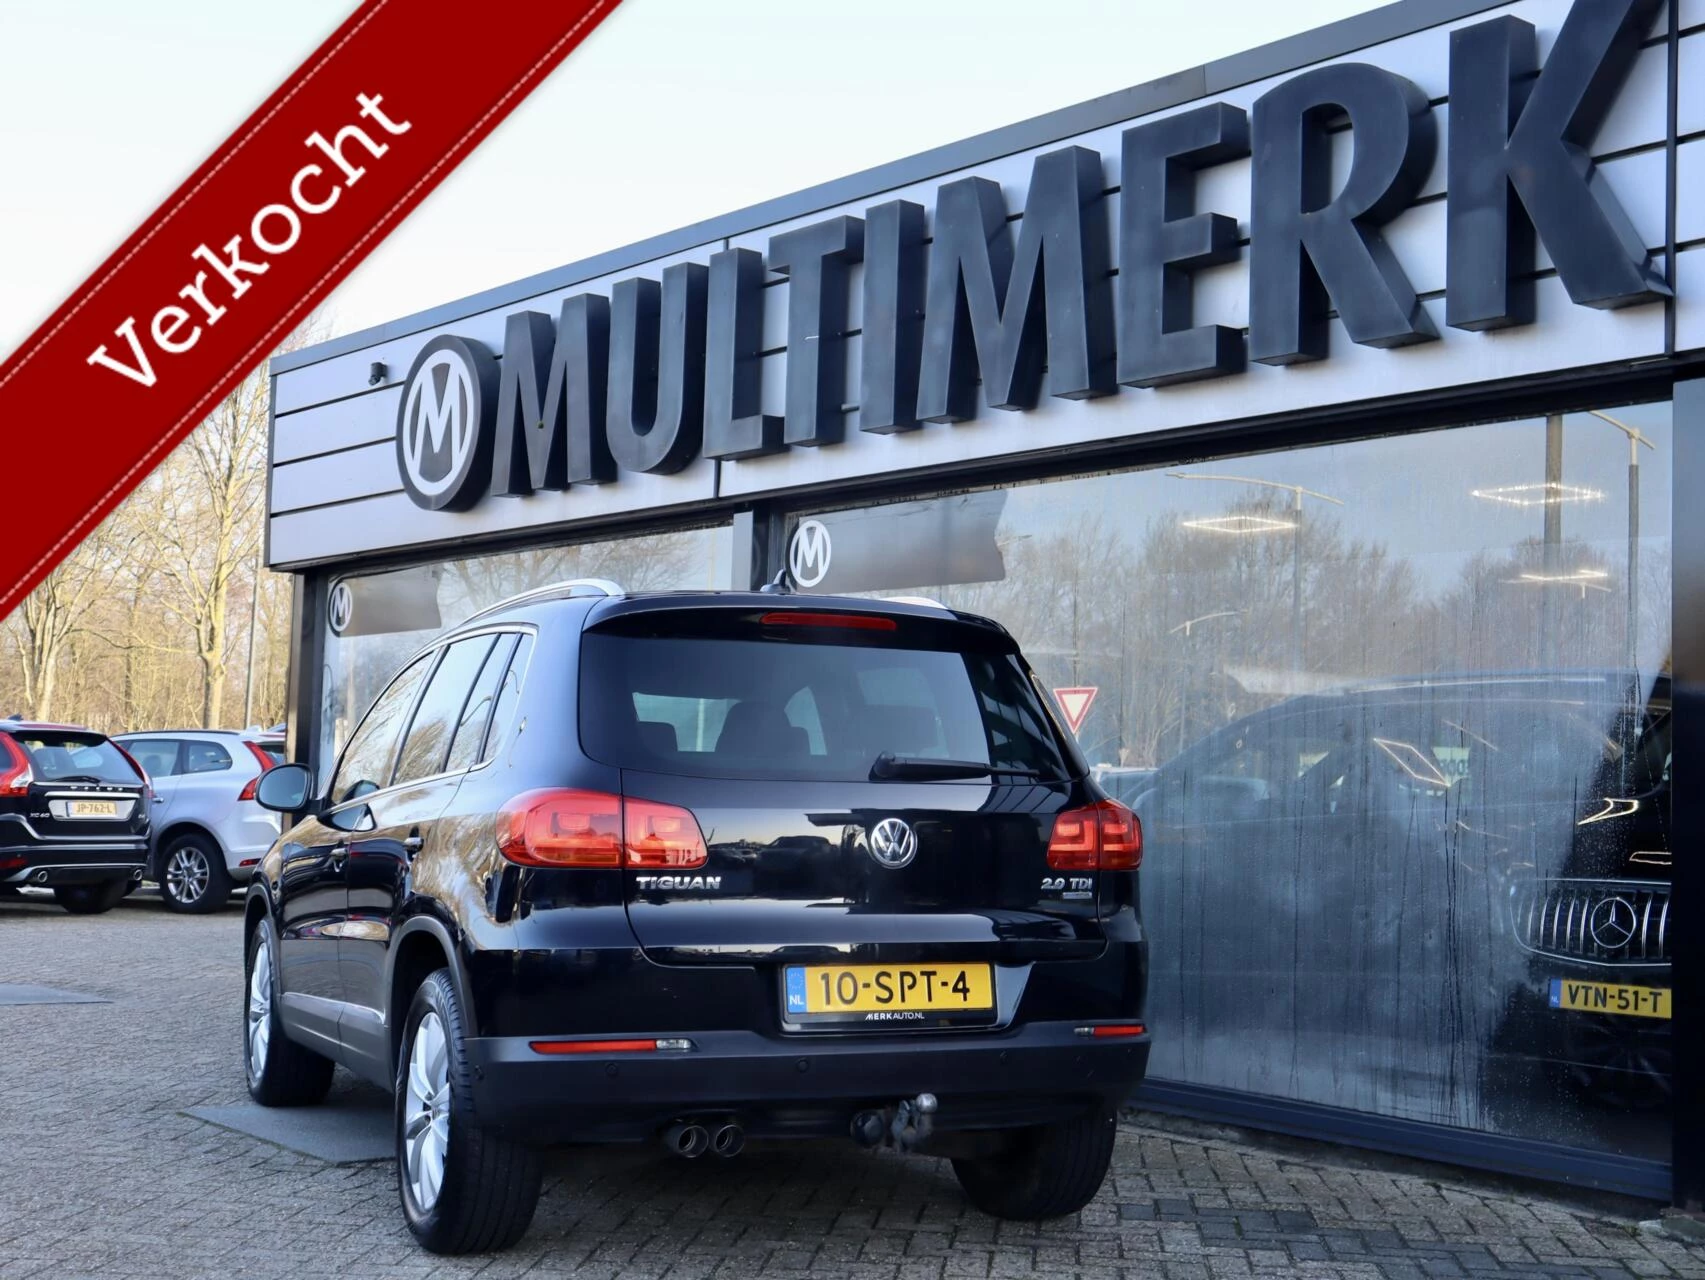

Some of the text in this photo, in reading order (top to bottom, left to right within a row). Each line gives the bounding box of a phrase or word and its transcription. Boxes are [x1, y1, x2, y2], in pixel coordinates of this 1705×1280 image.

[490, 0, 1672, 497] MULTIMERK
[636, 876, 722, 890] TIGUAN
[1070, 877, 1093, 890] TDI
[820, 970, 970, 1006] 10-SPT-4
[789, 996, 805, 1006] NL
[1567, 983, 1663, 1014] VTN-51-T
[864, 1011, 925, 1021] MERKAUTO.NL
